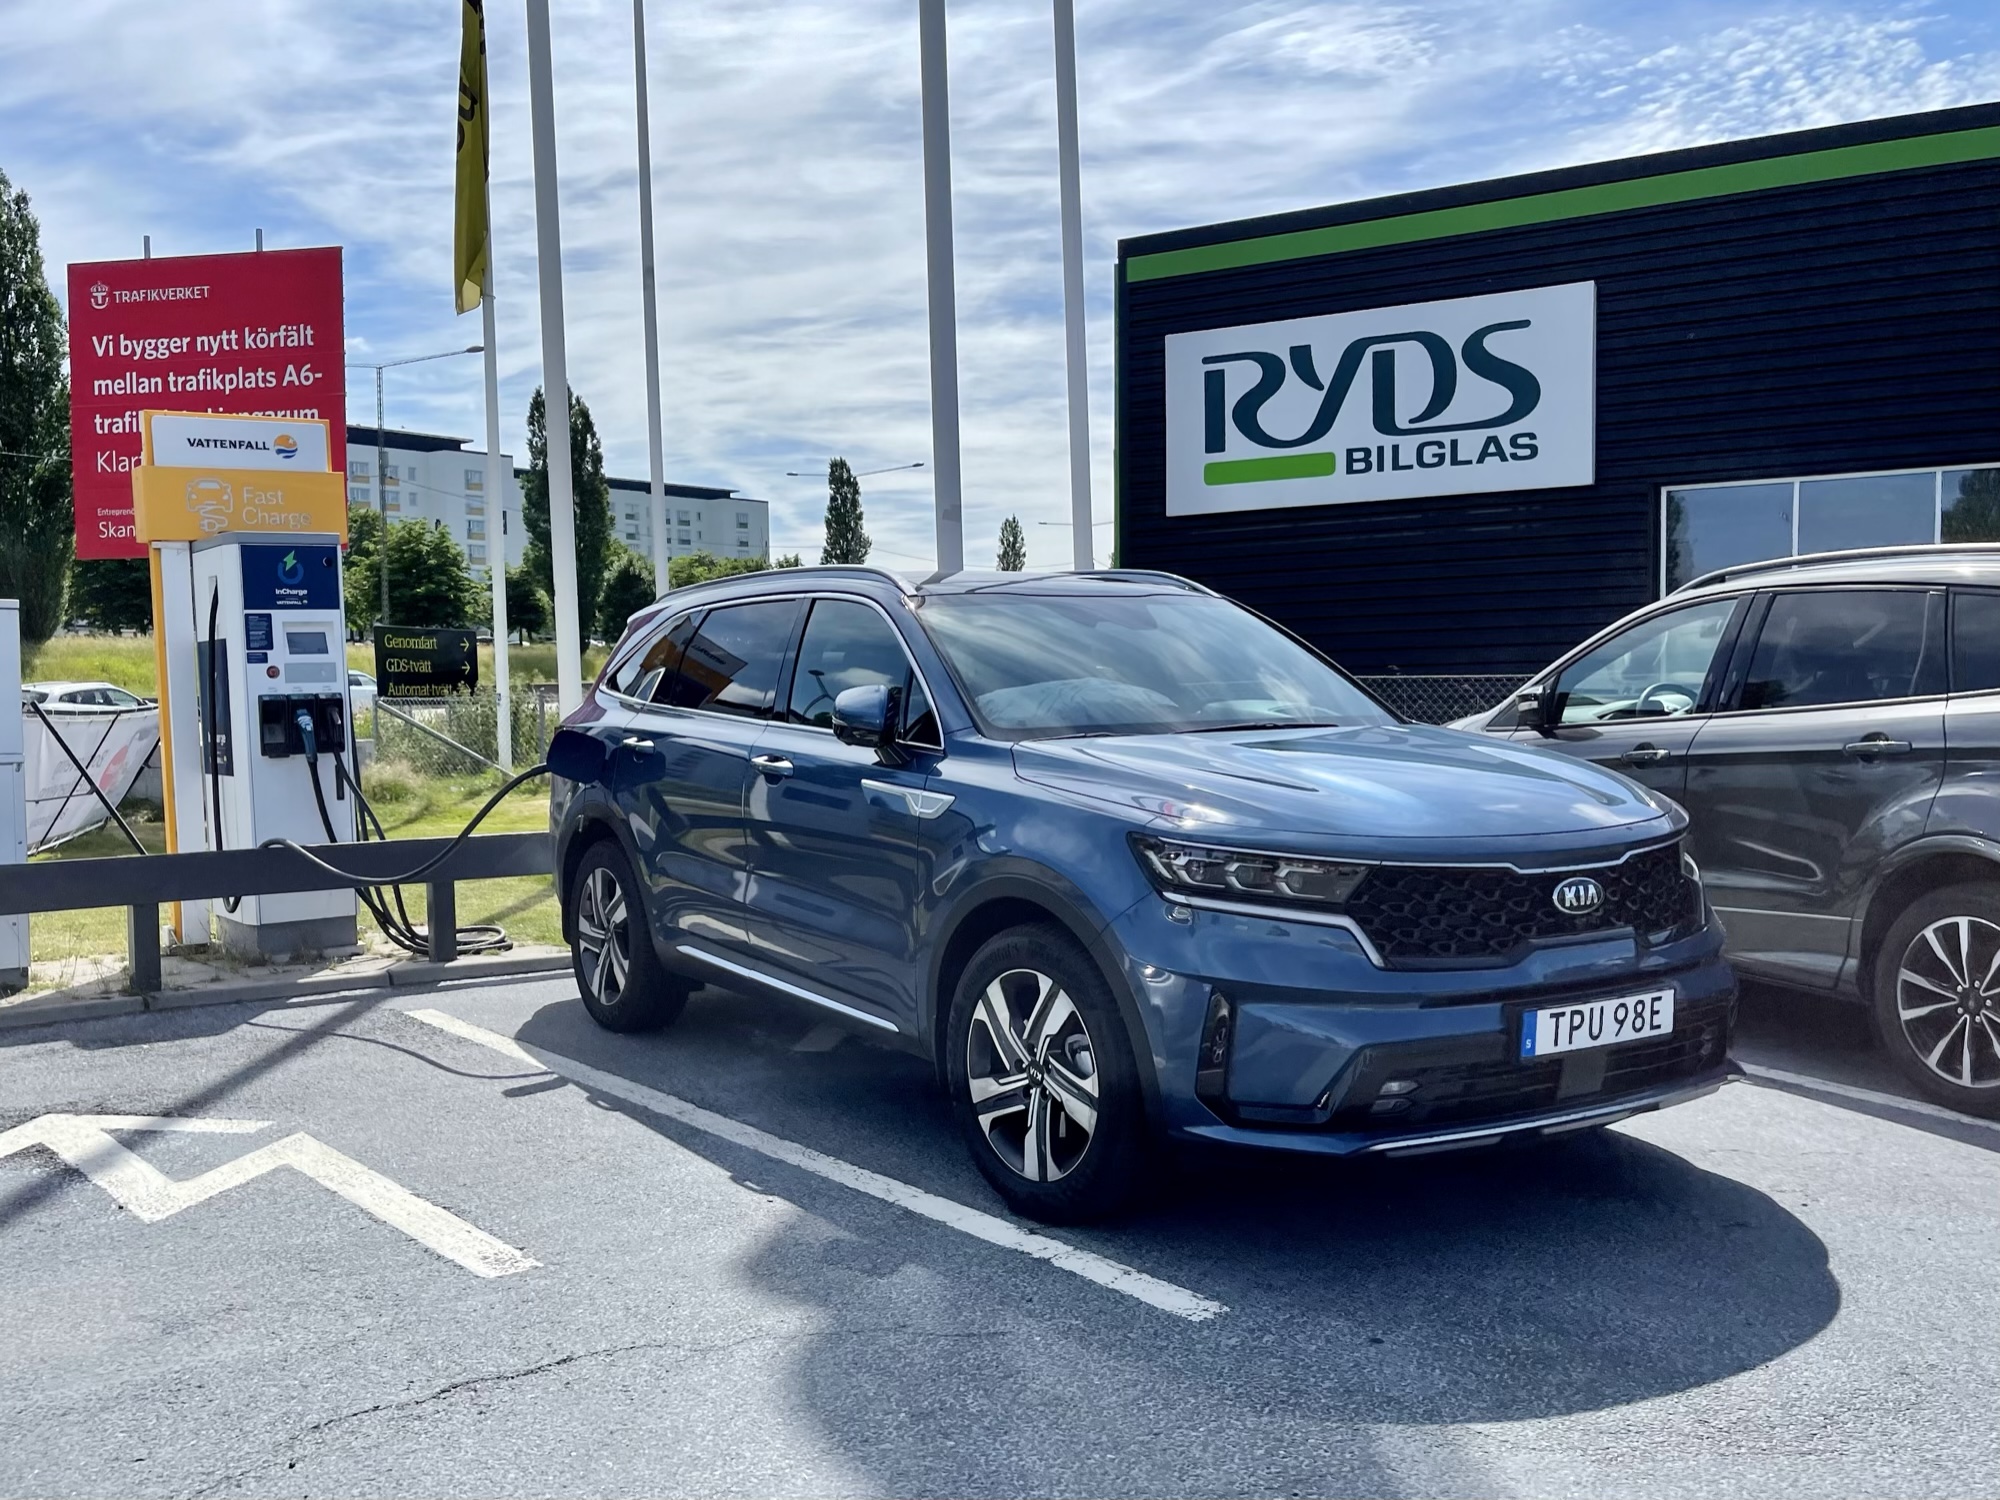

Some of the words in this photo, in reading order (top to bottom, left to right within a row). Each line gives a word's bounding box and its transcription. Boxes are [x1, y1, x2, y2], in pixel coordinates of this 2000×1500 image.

[113, 286, 210, 303] TRAFIKVERKET
[92, 335, 113, 357] Vi
[120, 334, 190, 360] bygger
[196, 329, 238, 356] nytt
[244, 324, 314, 349] körfält
[93, 371, 162, 396] mellan
[167, 366, 276, 395] trafikplats
[282, 364, 323, 387] A6-
[1201, 319, 1542, 454] RYDS
[94, 411, 144, 434] trafi
[186, 437, 270, 451] VATTENFALL
[1345, 432, 1539, 475] BILGLAS
[243, 486, 284, 505] Fast
[242, 506, 312, 529] Charge
[99, 521, 136, 539] Skan
[275, 588, 308, 597] InCharge
[385, 634, 437, 649] Genomfart
[386, 658, 432, 672] GDS-tvätt
[1563, 884, 1598, 906] KIA
[1549, 1004, 1604, 1047] TPU
[1613, 995, 1663, 1037] 98E
[1525, 1039, 1532, 1049] S
